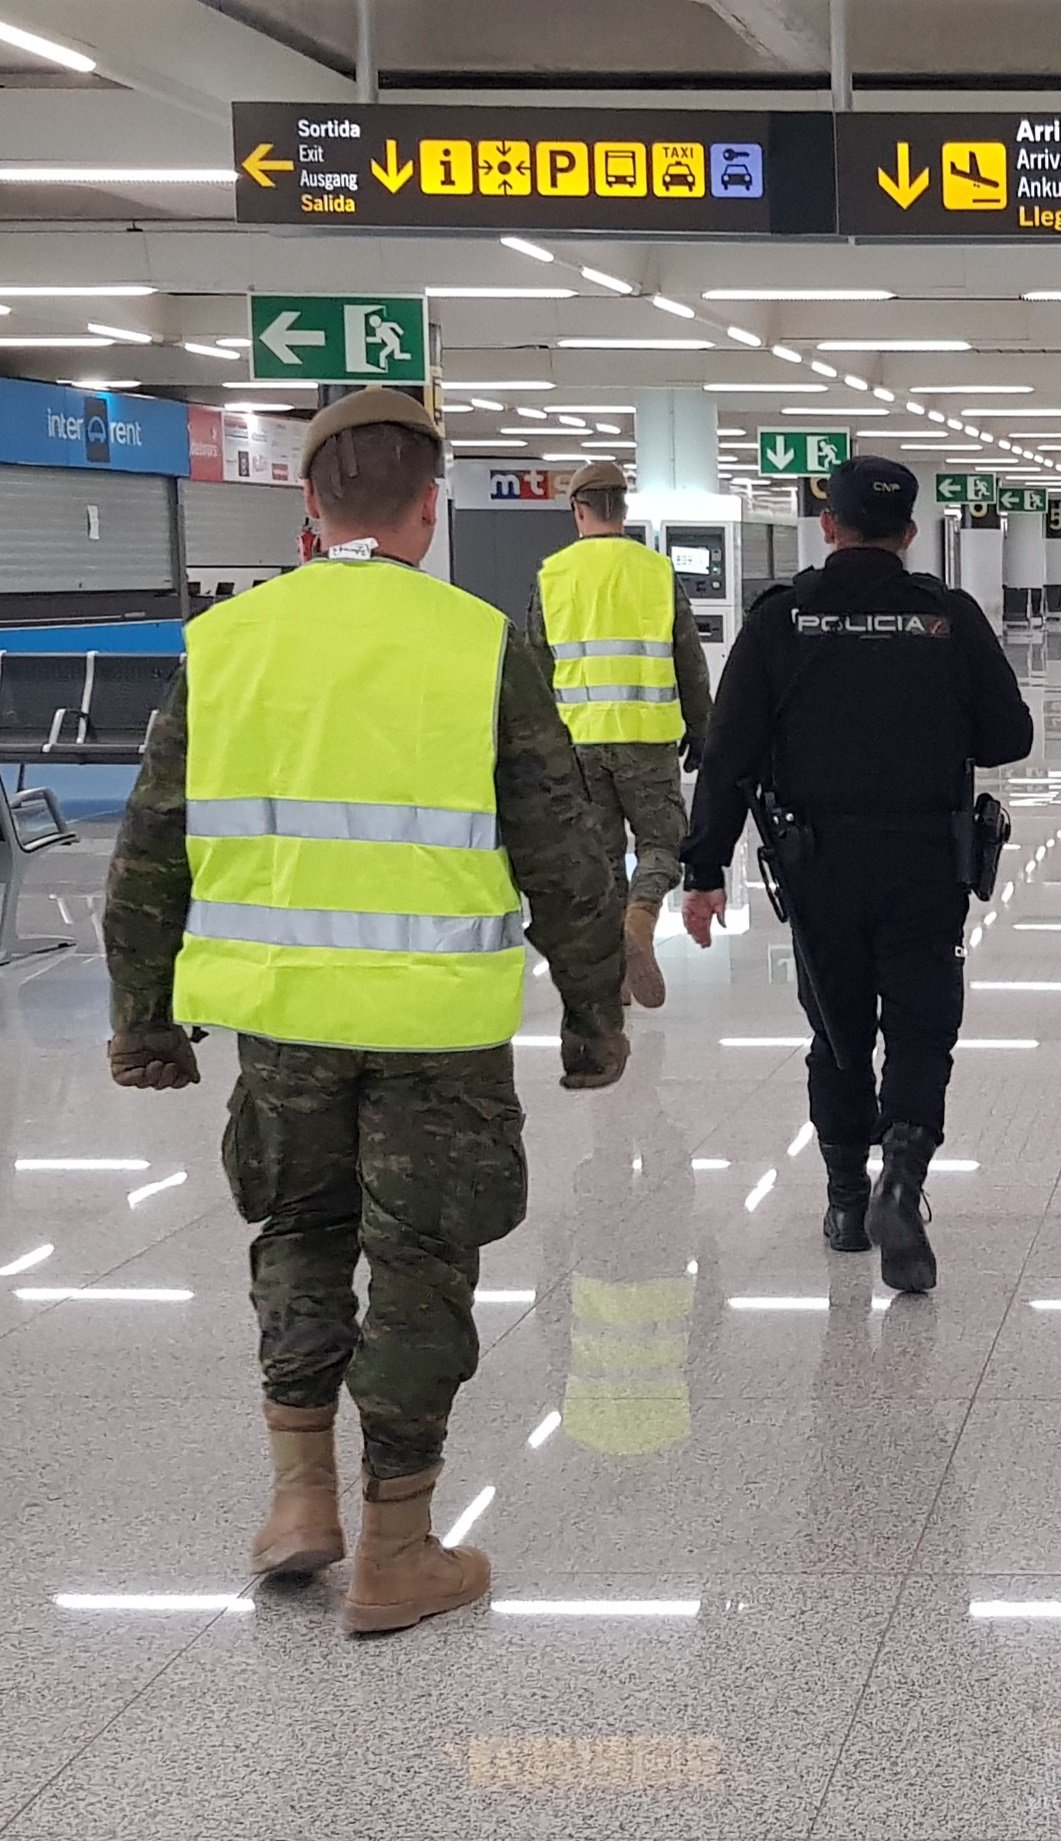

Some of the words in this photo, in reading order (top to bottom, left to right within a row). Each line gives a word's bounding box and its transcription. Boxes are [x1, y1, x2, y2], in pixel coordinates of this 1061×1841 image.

[298, 119, 360, 138] Sortida
[299, 145, 324, 164] Exit
[549, 150, 576, 188] P
[661, 147, 694, 159] TAXI
[300, 171, 358, 191] Ausgang
[301, 194, 355, 214] Salida
[872, 481, 901, 493] CNP
[798, 615, 926, 632] POLICIA
